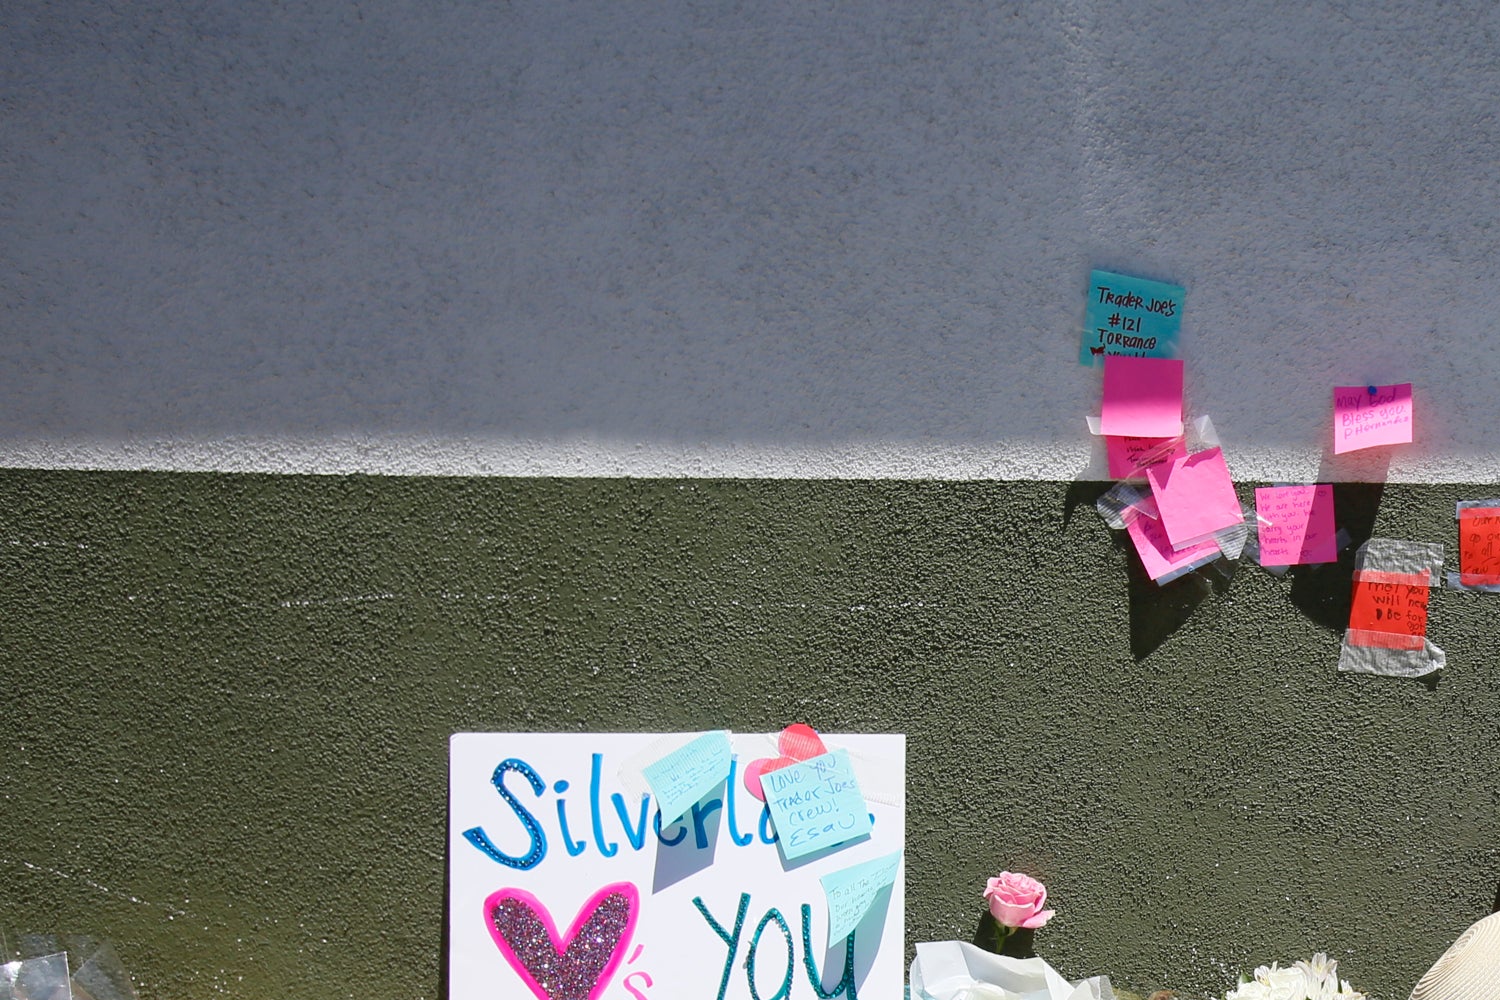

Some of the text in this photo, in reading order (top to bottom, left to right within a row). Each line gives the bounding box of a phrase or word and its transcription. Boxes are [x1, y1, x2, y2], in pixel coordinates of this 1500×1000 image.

[1107, 312, 1141, 332] #121
[1372, 592, 1400, 606] will
[1406, 584, 1424, 599] you
